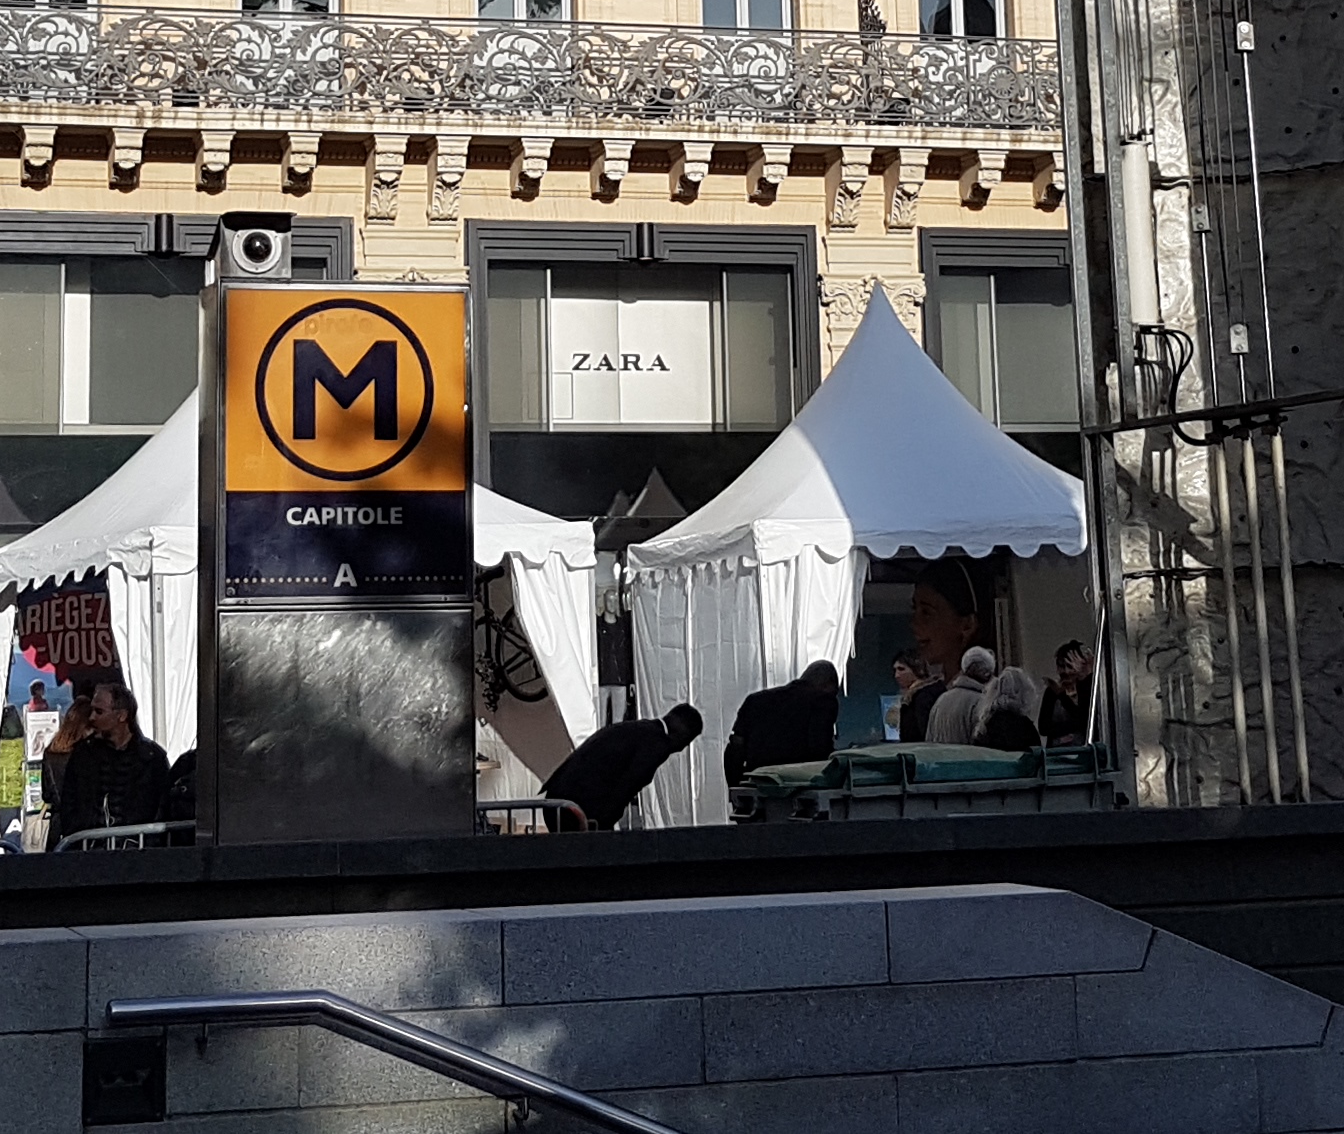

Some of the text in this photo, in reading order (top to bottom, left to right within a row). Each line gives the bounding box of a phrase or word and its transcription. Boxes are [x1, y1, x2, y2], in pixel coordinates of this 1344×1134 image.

[572, 353, 670, 371] ZARA
[293, 339, 398, 440] M
[286, 507, 403, 525] CAPITOLE
[333, 563, 357, 587] A
